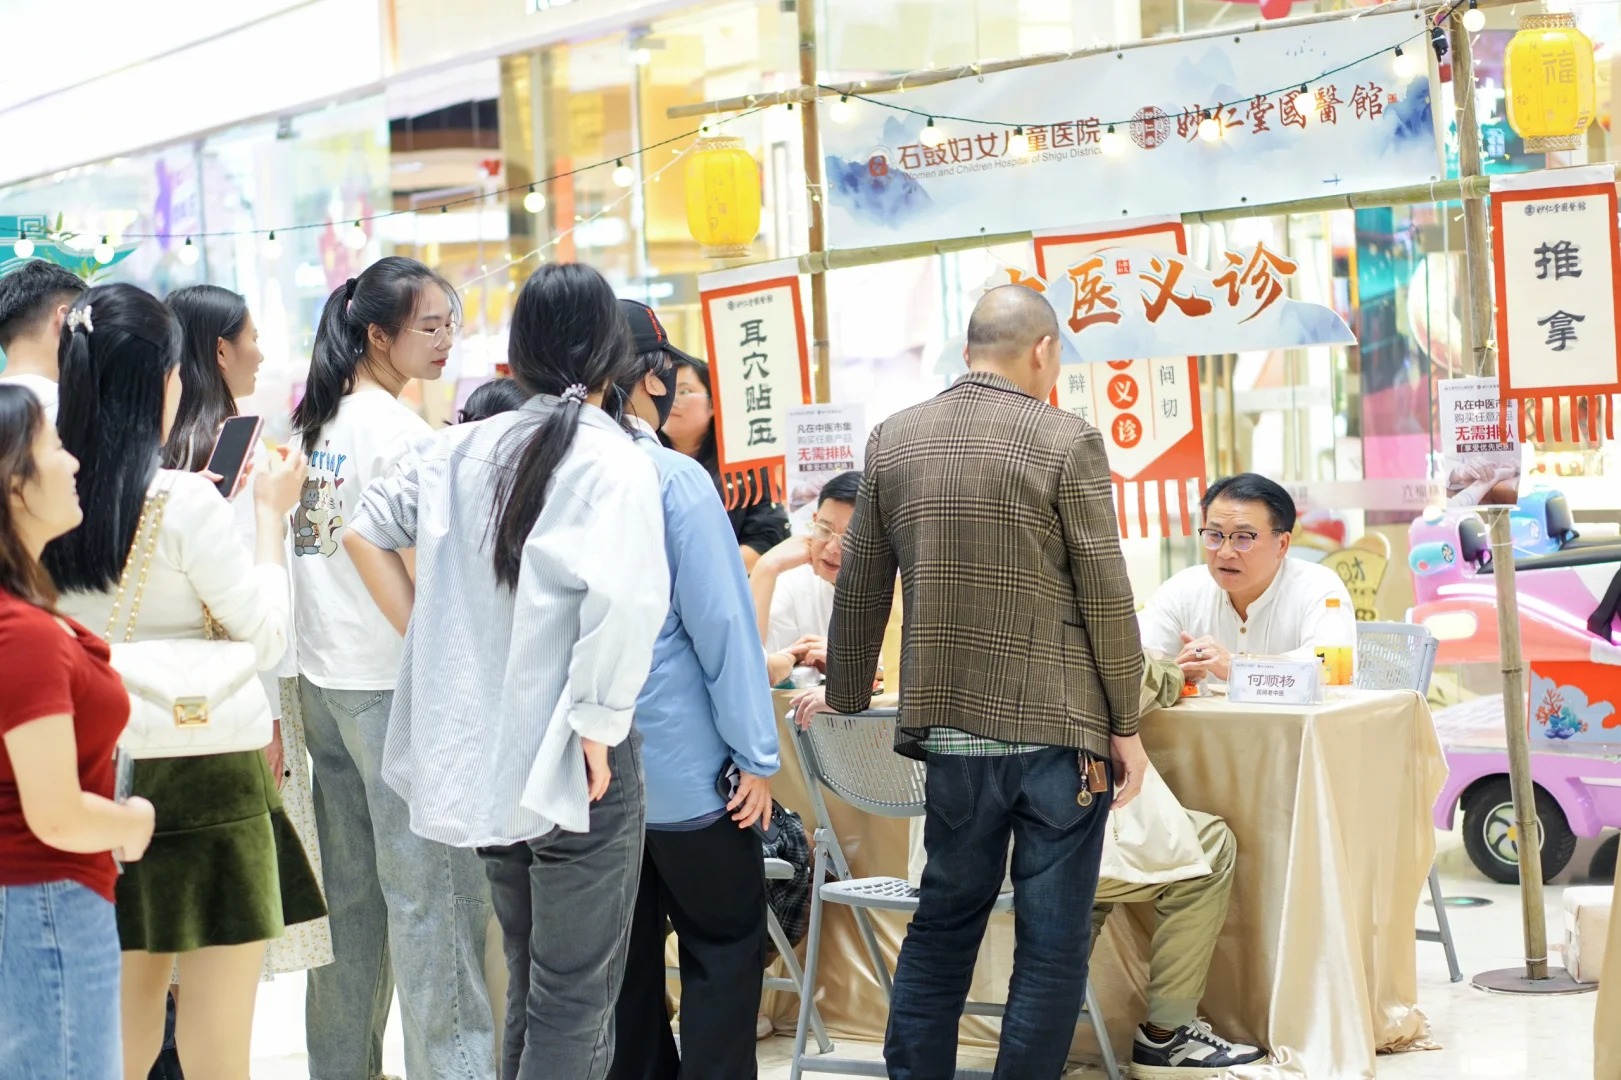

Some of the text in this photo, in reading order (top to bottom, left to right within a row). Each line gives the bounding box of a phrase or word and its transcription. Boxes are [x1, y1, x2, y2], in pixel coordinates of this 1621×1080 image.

[938, 168, 954, 177] and
[956, 162, 992, 175] Children
[994, 156, 1029, 170] Hospital
[1041, 151, 1068, 165] Shigu
[1533, 240, 1585, 351] 推拿
[740, 319, 777, 446] 耳穴贴压
[1110, 360, 1137, 442] 义诊
[1159, 365, 1178, 418] 问切
[797, 422, 852, 434] 凡在中医市集
[798, 445, 853, 461] 无需排队
[1248, 674, 1295, 687] 何顺杨
